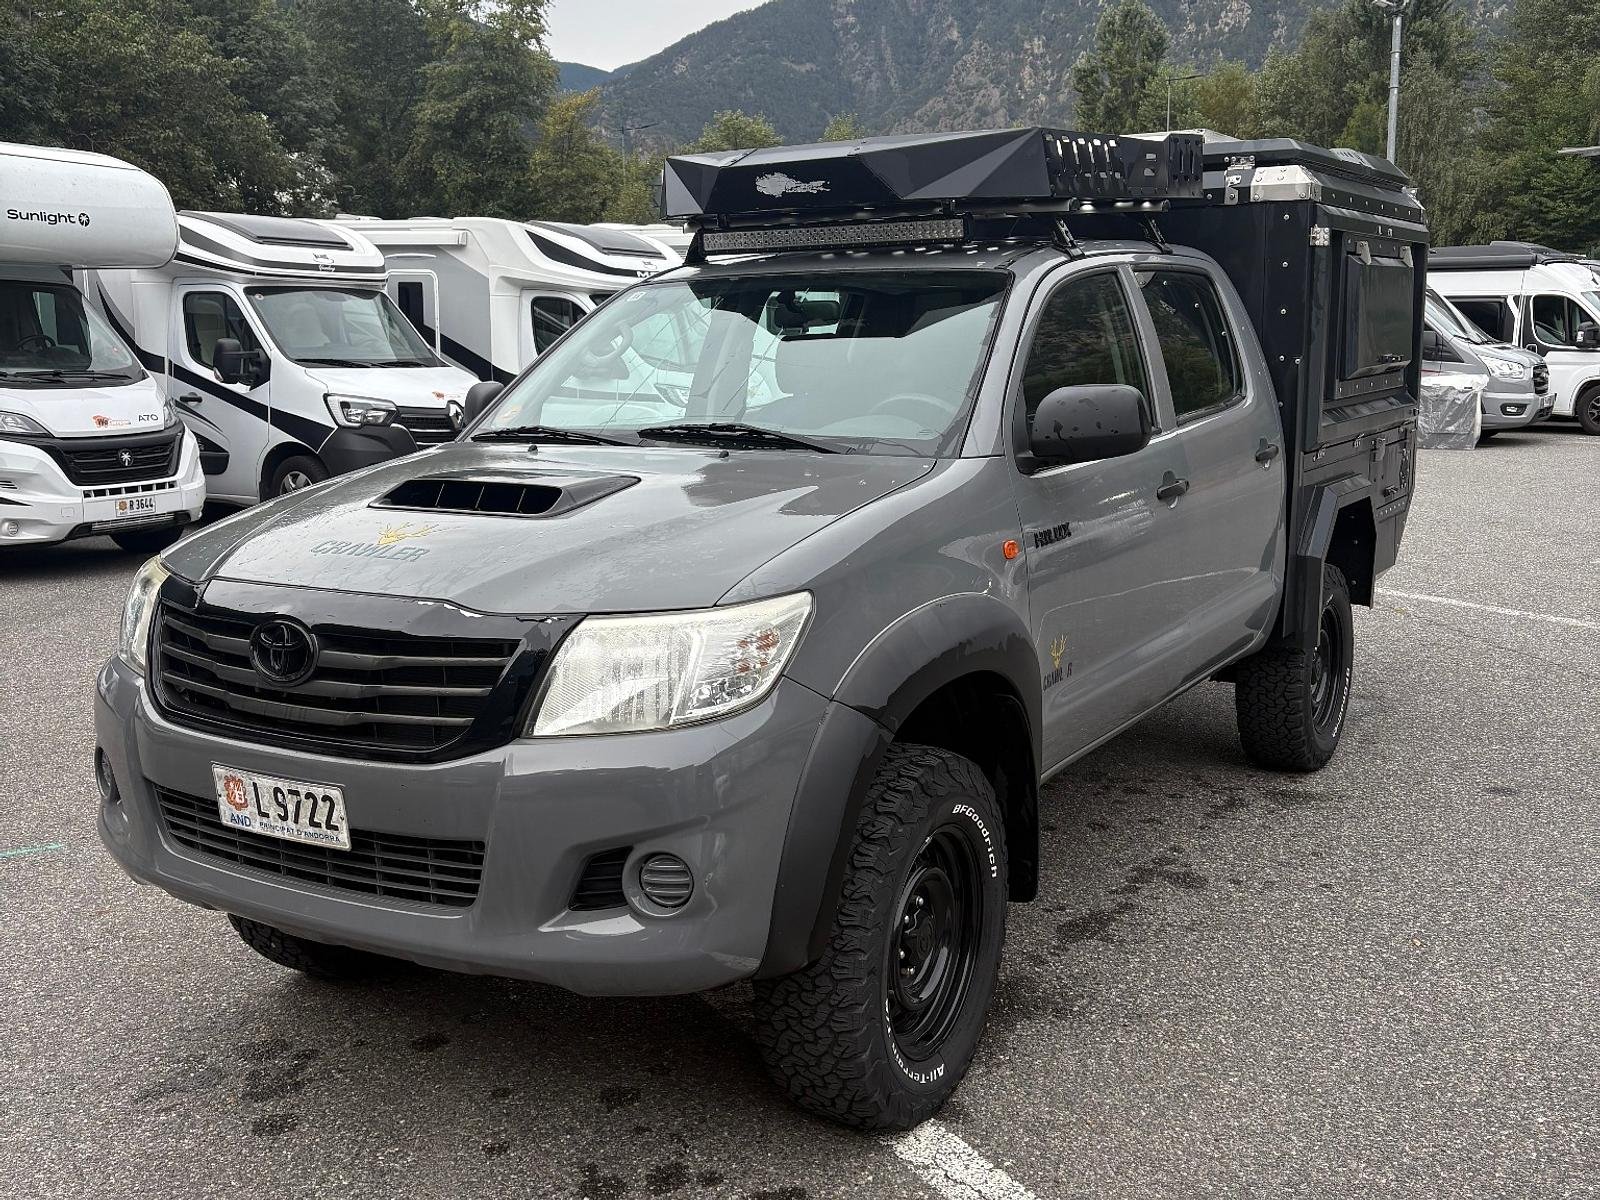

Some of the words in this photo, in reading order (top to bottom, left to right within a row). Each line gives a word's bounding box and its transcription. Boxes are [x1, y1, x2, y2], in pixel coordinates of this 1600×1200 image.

[7, 209, 76, 225] Sunlight
[136, 498, 154, 510] 3644
[311, 540, 430, 562] CRAWLER
[1043, 662, 1073, 691] CRAWLR
[252, 781, 270, 819] L
[273, 786, 339, 832] 9722
[230, 812, 252, 828] AND
[259, 821, 294, 836] PRINCIPAT
[296, 830, 341, 843] D'ANDORRA
[952, 804, 998, 878] BFGoodrich
